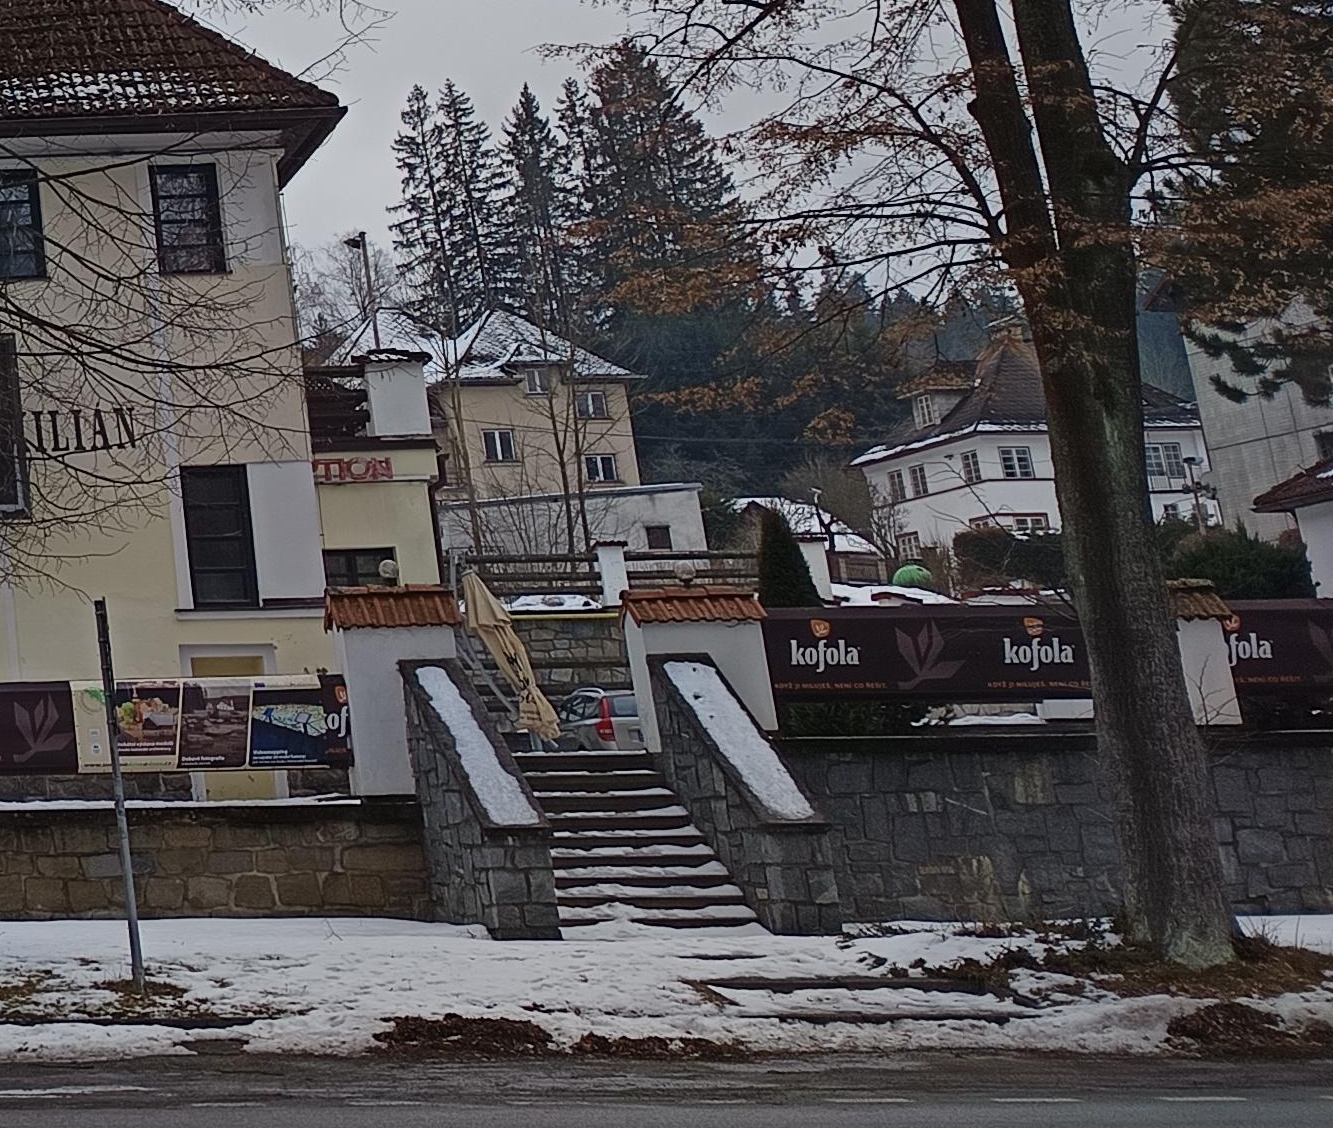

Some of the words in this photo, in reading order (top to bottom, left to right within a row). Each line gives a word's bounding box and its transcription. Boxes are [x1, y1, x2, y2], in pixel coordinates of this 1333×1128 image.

[22, 402, 135, 452] ILIÁN
[790, 639, 860, 673] kofola
[1003, 637, 1074, 671] kofola
[1229, 632, 1273, 667] fola
